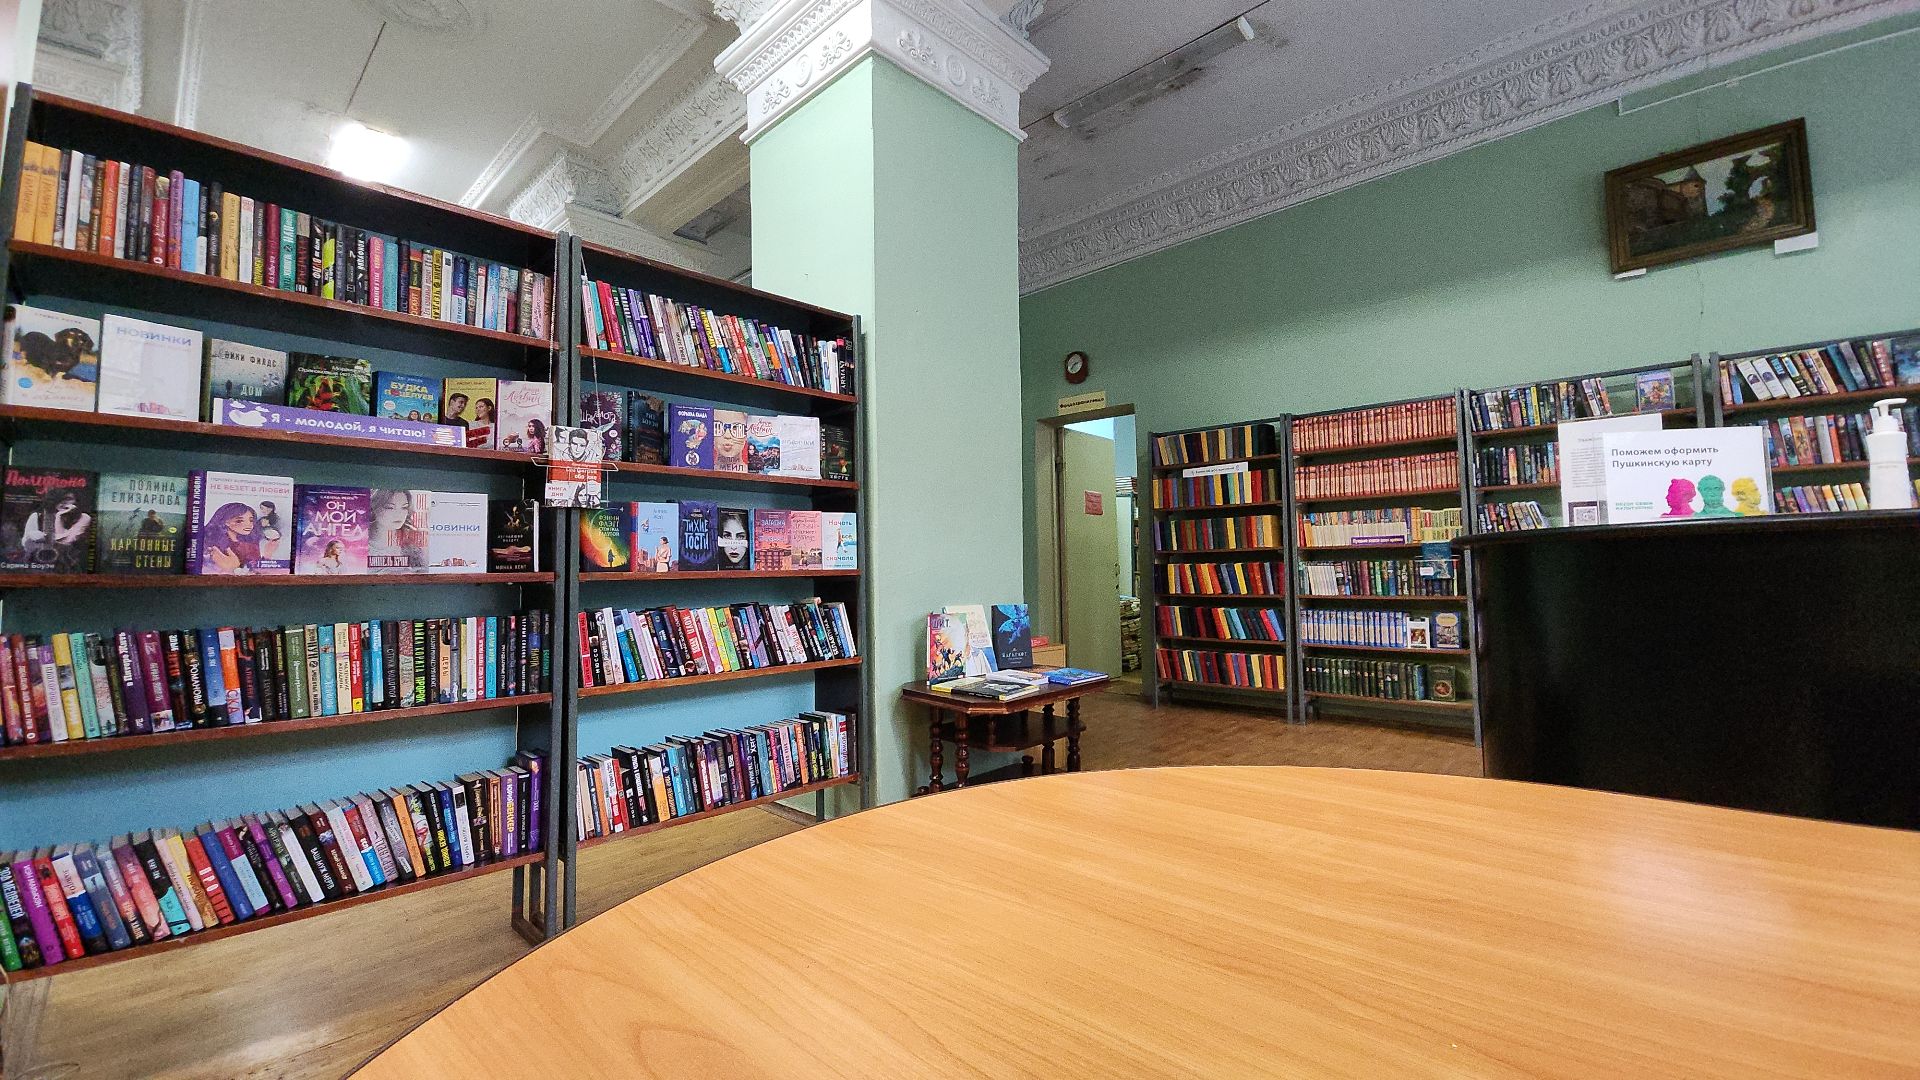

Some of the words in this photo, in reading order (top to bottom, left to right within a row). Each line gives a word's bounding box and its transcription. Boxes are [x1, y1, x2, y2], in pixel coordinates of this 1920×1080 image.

[116, 327, 192, 347] НОВИНКИ
[224, 350, 245, 362] ВИКИ
[250, 356, 277, 368] ФИЛДС
[241, 385, 263, 397] ДОМ
[390, 381, 428, 393] БУДКА
[1611, 448, 1661, 457] Поможем
[1664, 446, 1719, 457] оформить
[1612, 459, 1680, 469] Пушкинскую
[1682, 458, 1712, 468] карту
[129, 479, 176, 492] ПОЛИНА
[259, 487, 290, 495] ЛЮБВИ
[112, 493, 181, 506] ЕЛИЗАРОВА
[326, 501, 345, 510] ОН
[314, 510, 358, 522] МОЙ
[303, 523, 364, 536] АНГЕЛ
[111, 538, 176, 552] КАРТОННЫЕ
[135, 555, 172, 568] СТЕНЫ
[191, 664, 203, 705] РОМАНОВЫ
[416, 676, 426, 703] ПРОРОК
